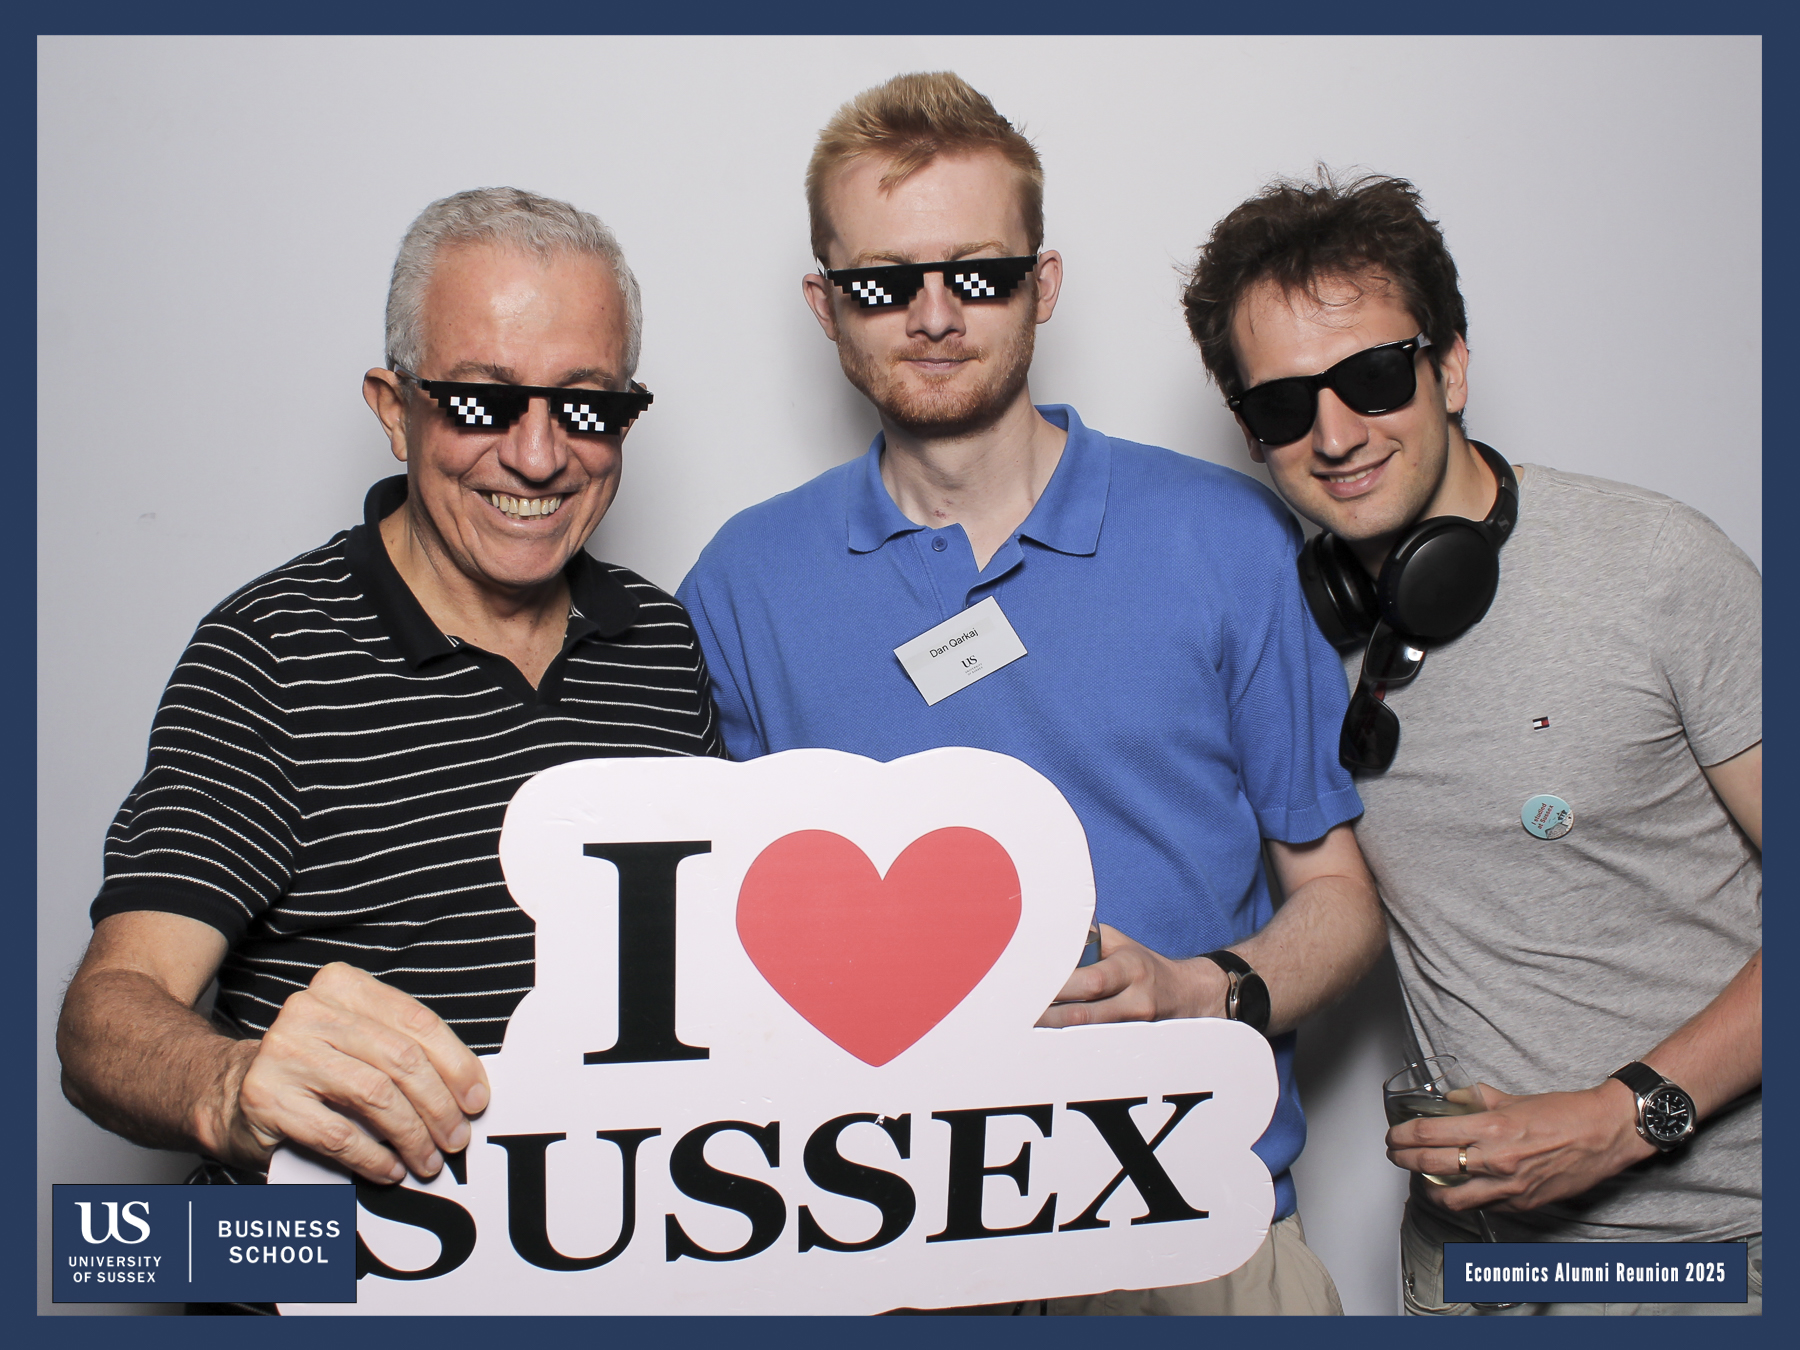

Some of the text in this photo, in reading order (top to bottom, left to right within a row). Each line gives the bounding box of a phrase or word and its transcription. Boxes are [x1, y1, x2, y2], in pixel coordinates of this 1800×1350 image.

[929, 627, 979, 658] Dan Qarkaj
[961, 655, 978, 668] US
[1540, 804, 1554, 823] Sussex
[583, 840, 712, 1065] I
[357, 1091, 1213, 1282] SUSSEX
